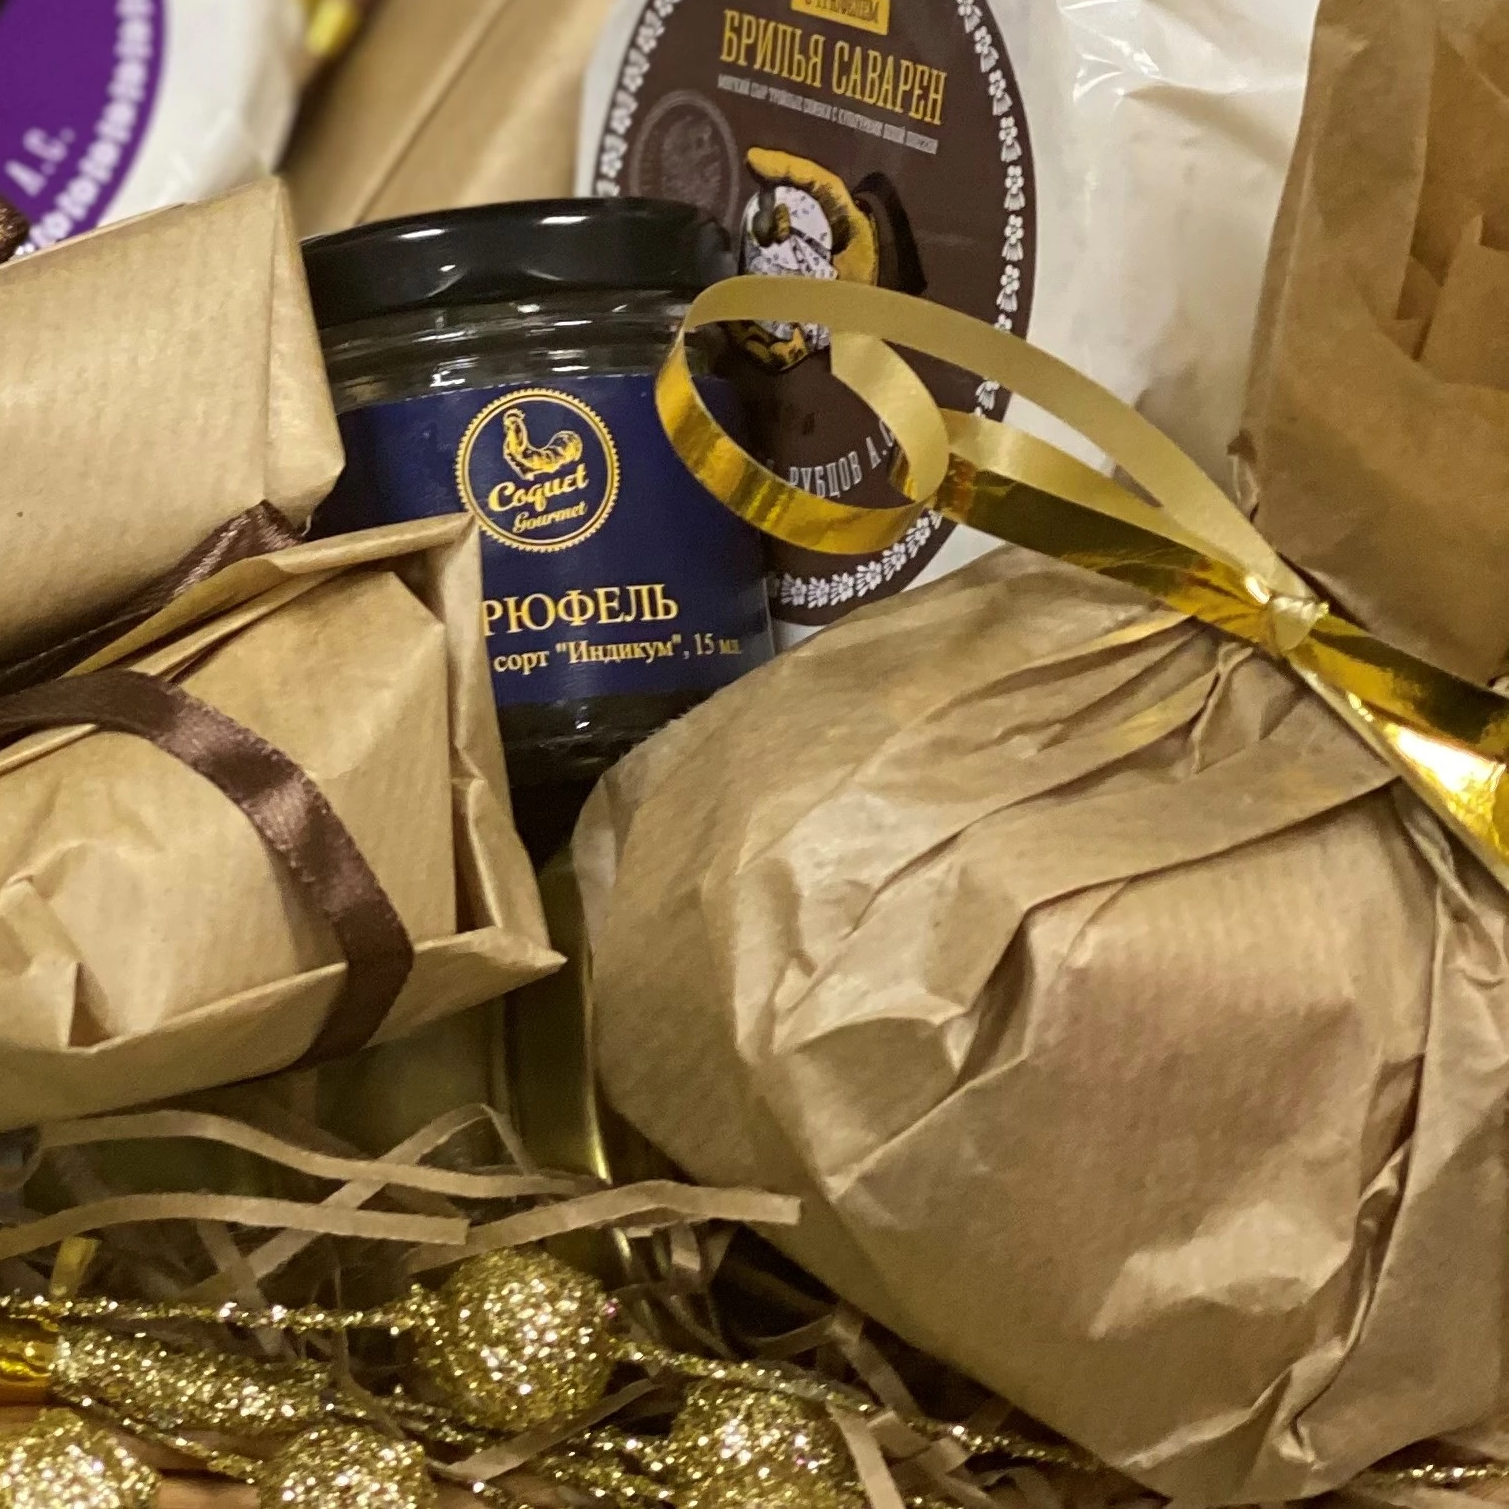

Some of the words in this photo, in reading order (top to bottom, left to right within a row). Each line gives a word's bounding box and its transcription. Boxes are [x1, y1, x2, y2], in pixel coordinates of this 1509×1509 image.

[719, 8, 826, 88] БРИЛЬЯ
[831, 40, 948, 126] САВАРЕН
[488, 462, 589, 512] Coquet
[788, 450, 863, 499] РУБЦОВ
[512, 500, 588, 533] Gourmet
[481, 583, 679, 637] РЮФЕЛЬ
[493, 650, 550, 675] сорт
[694, 633, 715, 656] 15
